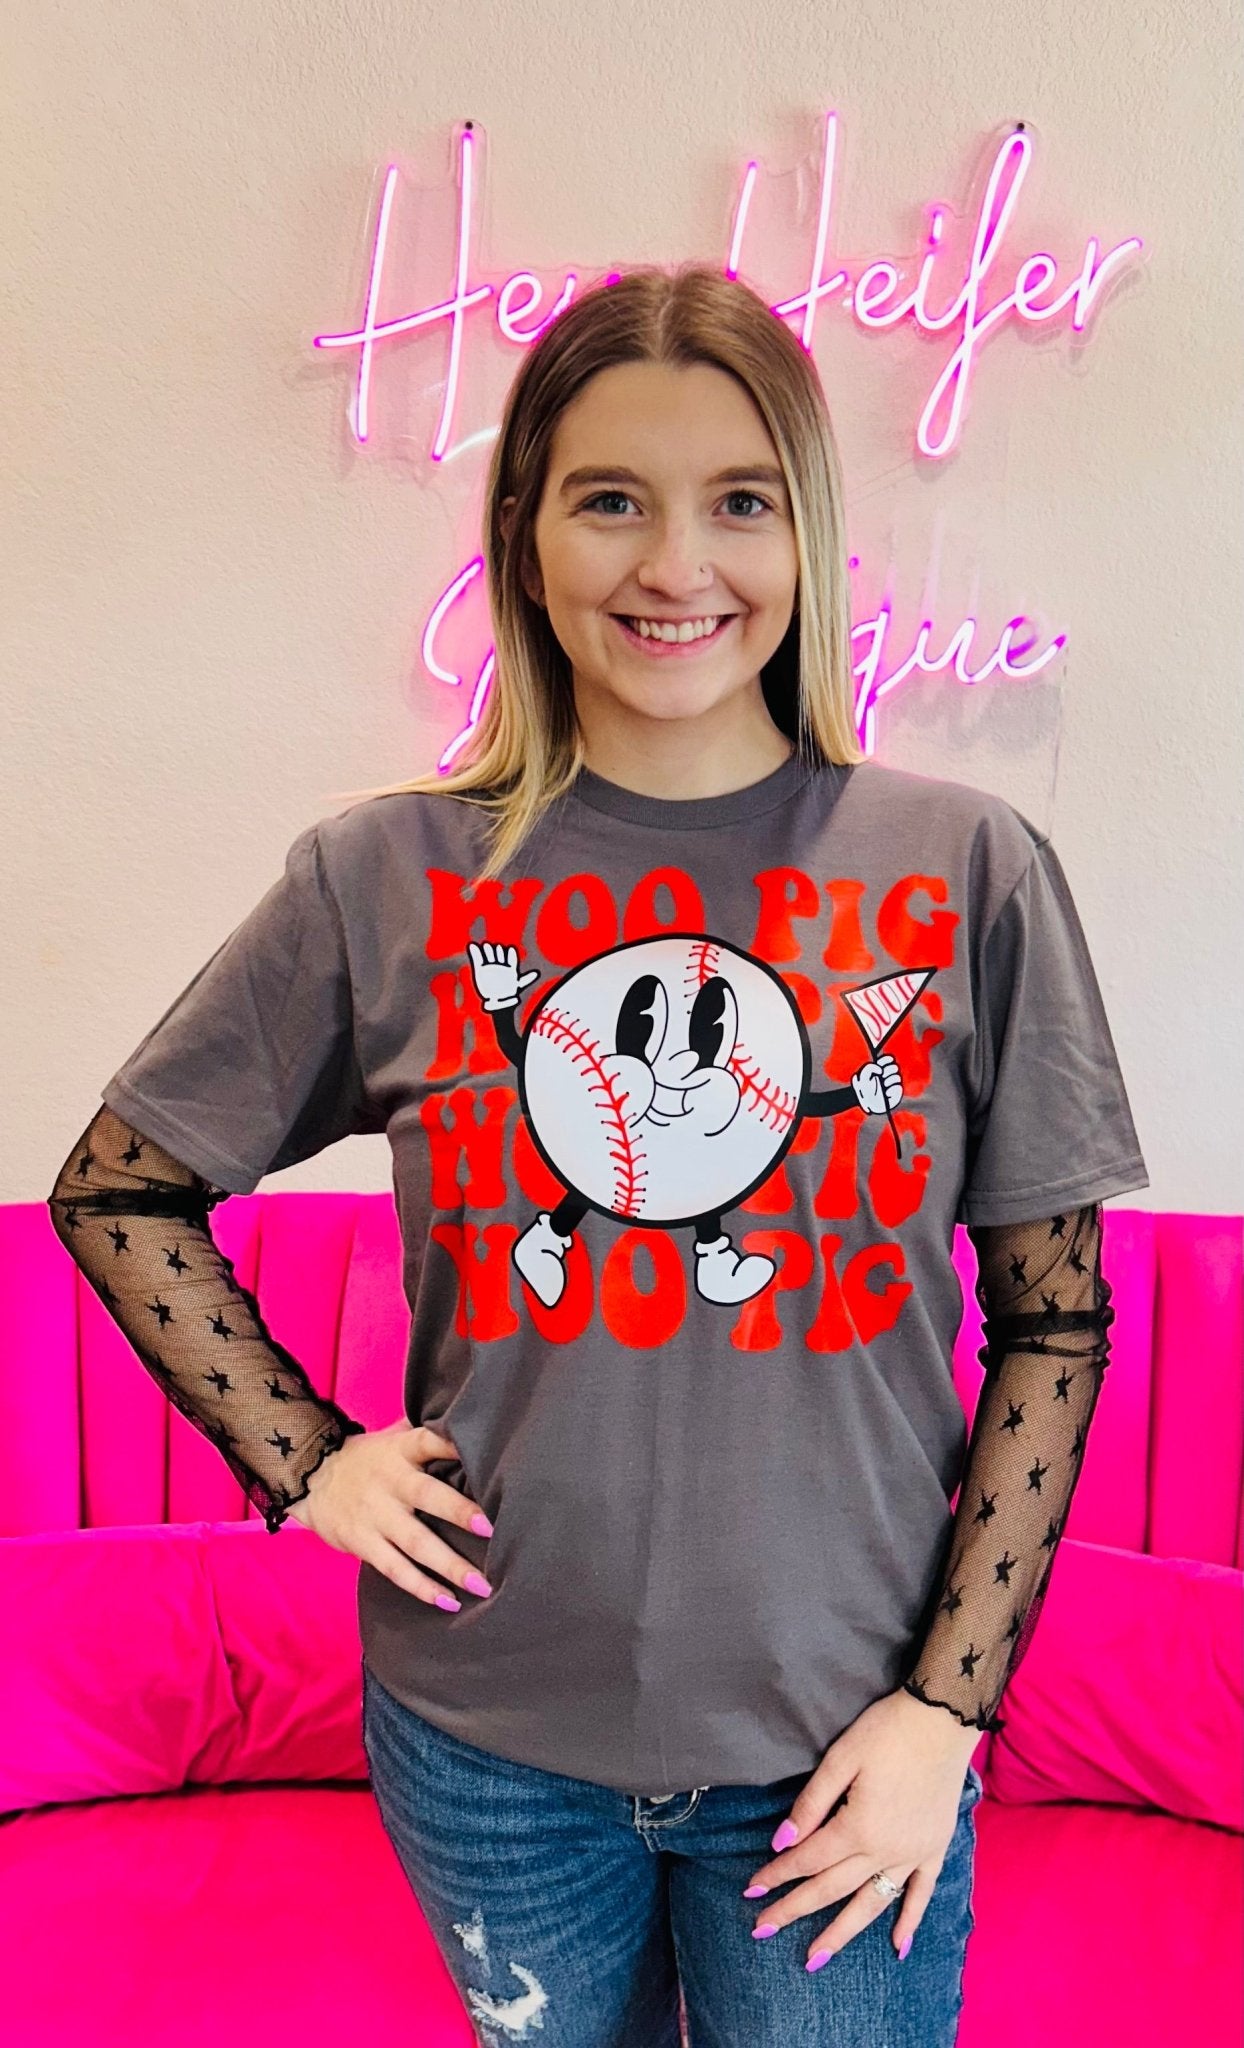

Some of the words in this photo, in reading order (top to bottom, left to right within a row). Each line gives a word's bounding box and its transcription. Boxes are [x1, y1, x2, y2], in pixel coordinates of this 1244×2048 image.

[315, 126, 619, 461] He
[425, 866, 706, 968] WOO
[749, 866, 960, 972] PIG
[431, 1222, 687, 1350] WOO
[730, 1230, 914, 1354] PIG
